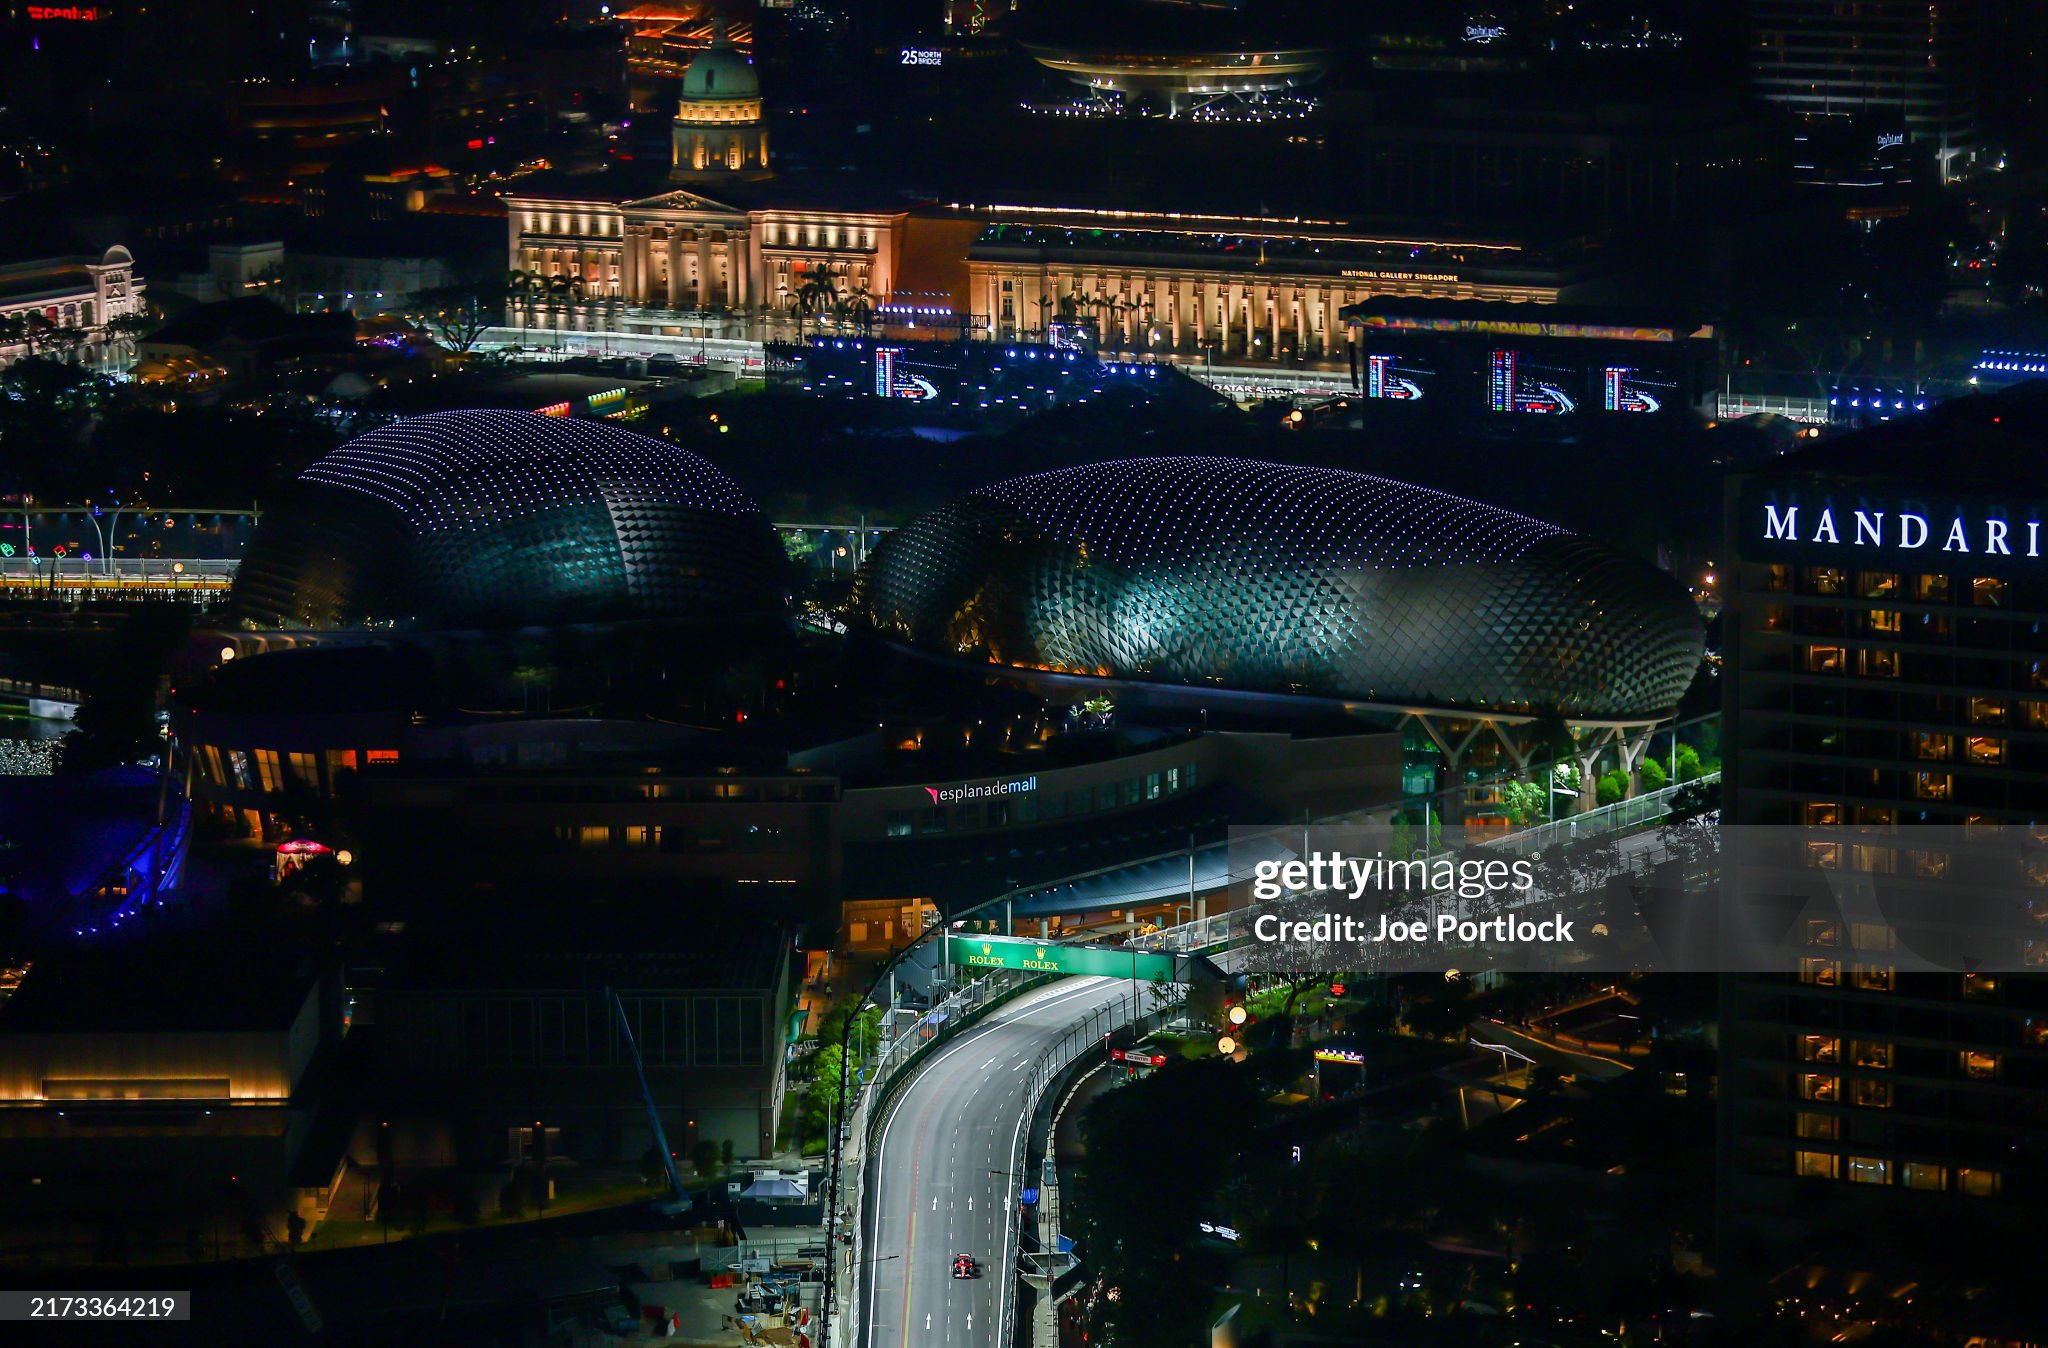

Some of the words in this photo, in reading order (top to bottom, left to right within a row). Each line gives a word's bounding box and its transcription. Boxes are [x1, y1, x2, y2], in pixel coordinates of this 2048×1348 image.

[901, 50, 918, 65] 25
[1341, 270, 1378, 278] NATIONAL
[1380, 271, 1413, 280] GALLERY
[1414, 273, 1459, 282] SINGAPORE
[1477, 320, 1541, 336] PADANG
[1763, 504, 2041, 558] MANDARI
[940, 776, 1037, 804] esplanademall
[969, 955, 1005, 966] ROLEX
[1022, 959, 1059, 971] ROLEX
